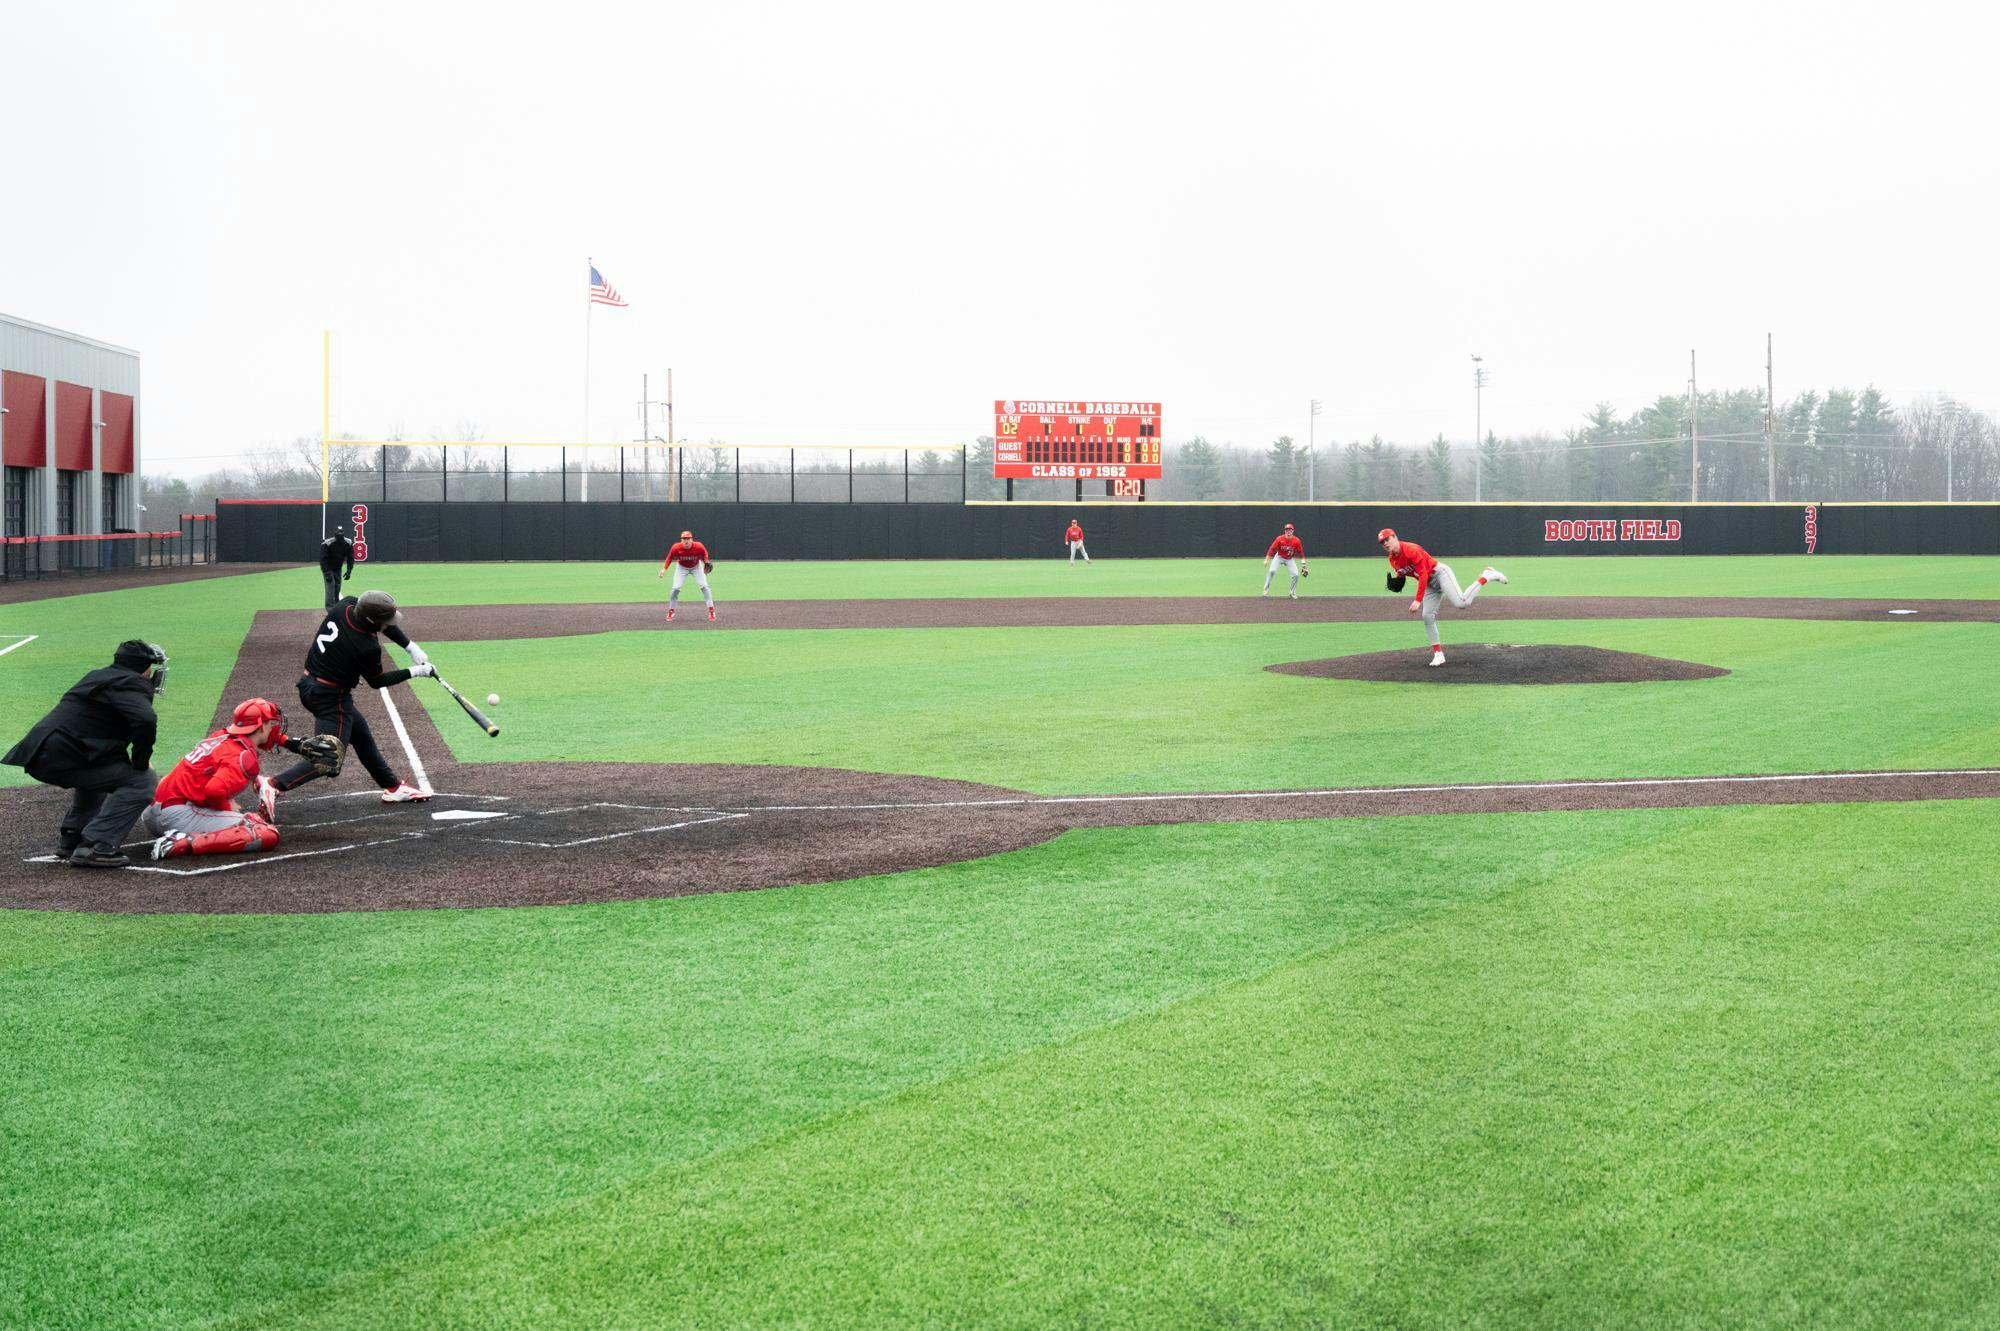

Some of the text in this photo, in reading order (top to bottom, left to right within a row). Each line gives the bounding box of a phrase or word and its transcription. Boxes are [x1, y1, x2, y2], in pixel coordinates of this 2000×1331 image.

[1019, 402, 1156, 415] CORNELL BASEBALL
[1009, 416, 1021, 424] BAT
[1040, 416, 1056, 424] BALL
[1068, 416, 1091, 424] STRIKE
[1104, 417, 1117, 425] OUT
[1106, 424, 1114, 436] 0
[998, 442, 1023, 451] GUEST
[998, 453, 1023, 461] CORNELL
[1032, 465, 1075, 477] CLASS
[352, 504, 368, 561] 318
[1545, 520, 1681, 541] BOOTH FIELD
[1805, 505, 1817, 553] 397
[316, 621, 339, 654] 2
